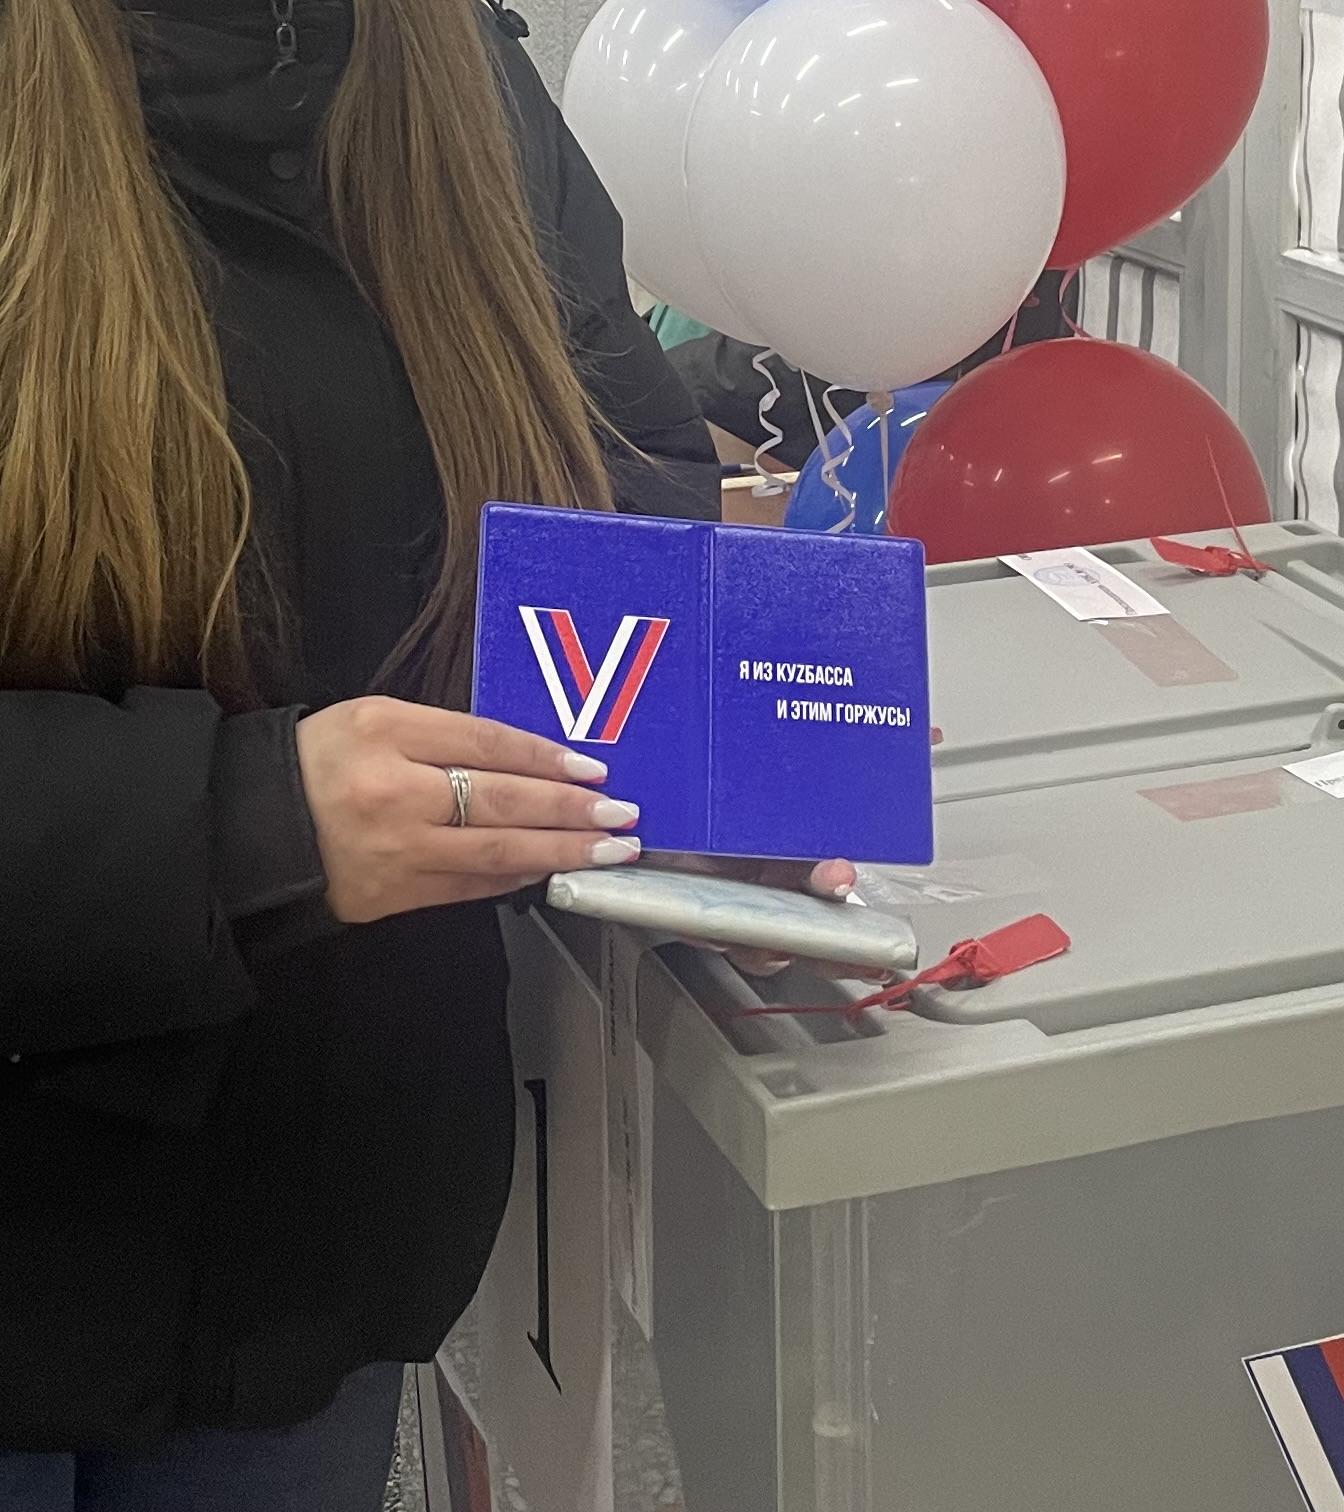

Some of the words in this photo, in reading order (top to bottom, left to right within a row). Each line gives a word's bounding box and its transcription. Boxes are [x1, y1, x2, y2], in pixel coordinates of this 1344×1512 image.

[739, 660, 749, 680] Я
[753, 661, 773, 682] ИЗ
[777, 699, 787, 719] И
[791, 700, 832, 722] ЭТИМ
[836, 703, 911, 727] ГОРЖУСЬ!
